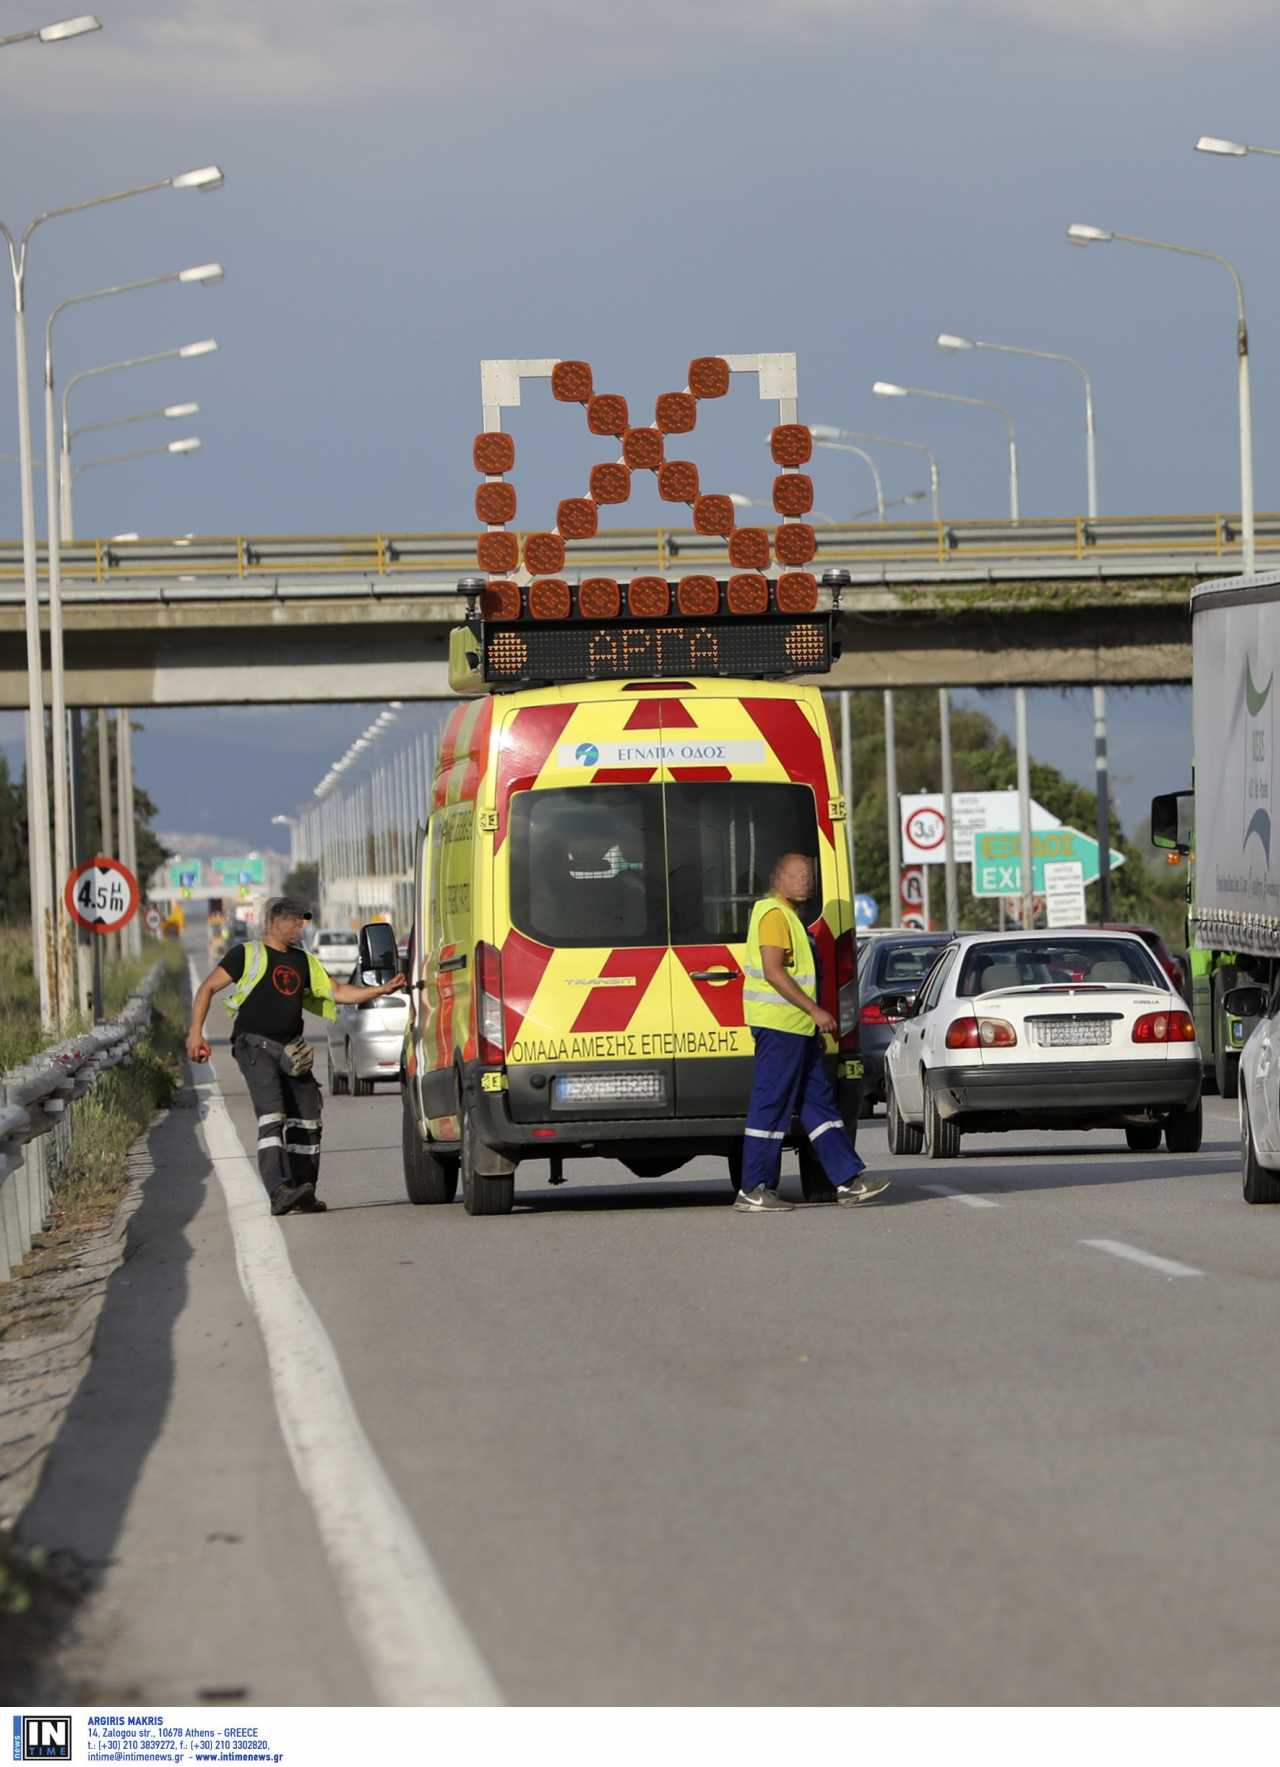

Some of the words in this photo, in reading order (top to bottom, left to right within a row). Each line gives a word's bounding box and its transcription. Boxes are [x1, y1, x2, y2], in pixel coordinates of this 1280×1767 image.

[588, 626, 720, 672] ΑΡΓΑ
[617, 746, 675, 761] ΕΓΝΑΤΙΑ
[681, 745, 726, 759] ΟΔΟΣ
[982, 866, 1038, 889] EXI
[78, 879, 108, 910] 4.5
[110, 896, 124, 912] m
[511, 1038, 570, 1063] ΟΜΑΔΑ
[571, 1034, 638, 1060] ΑΜΕΣΗΣ
[641, 1030, 739, 1056] ΕΠΕΜΒΑΣΗΣ
